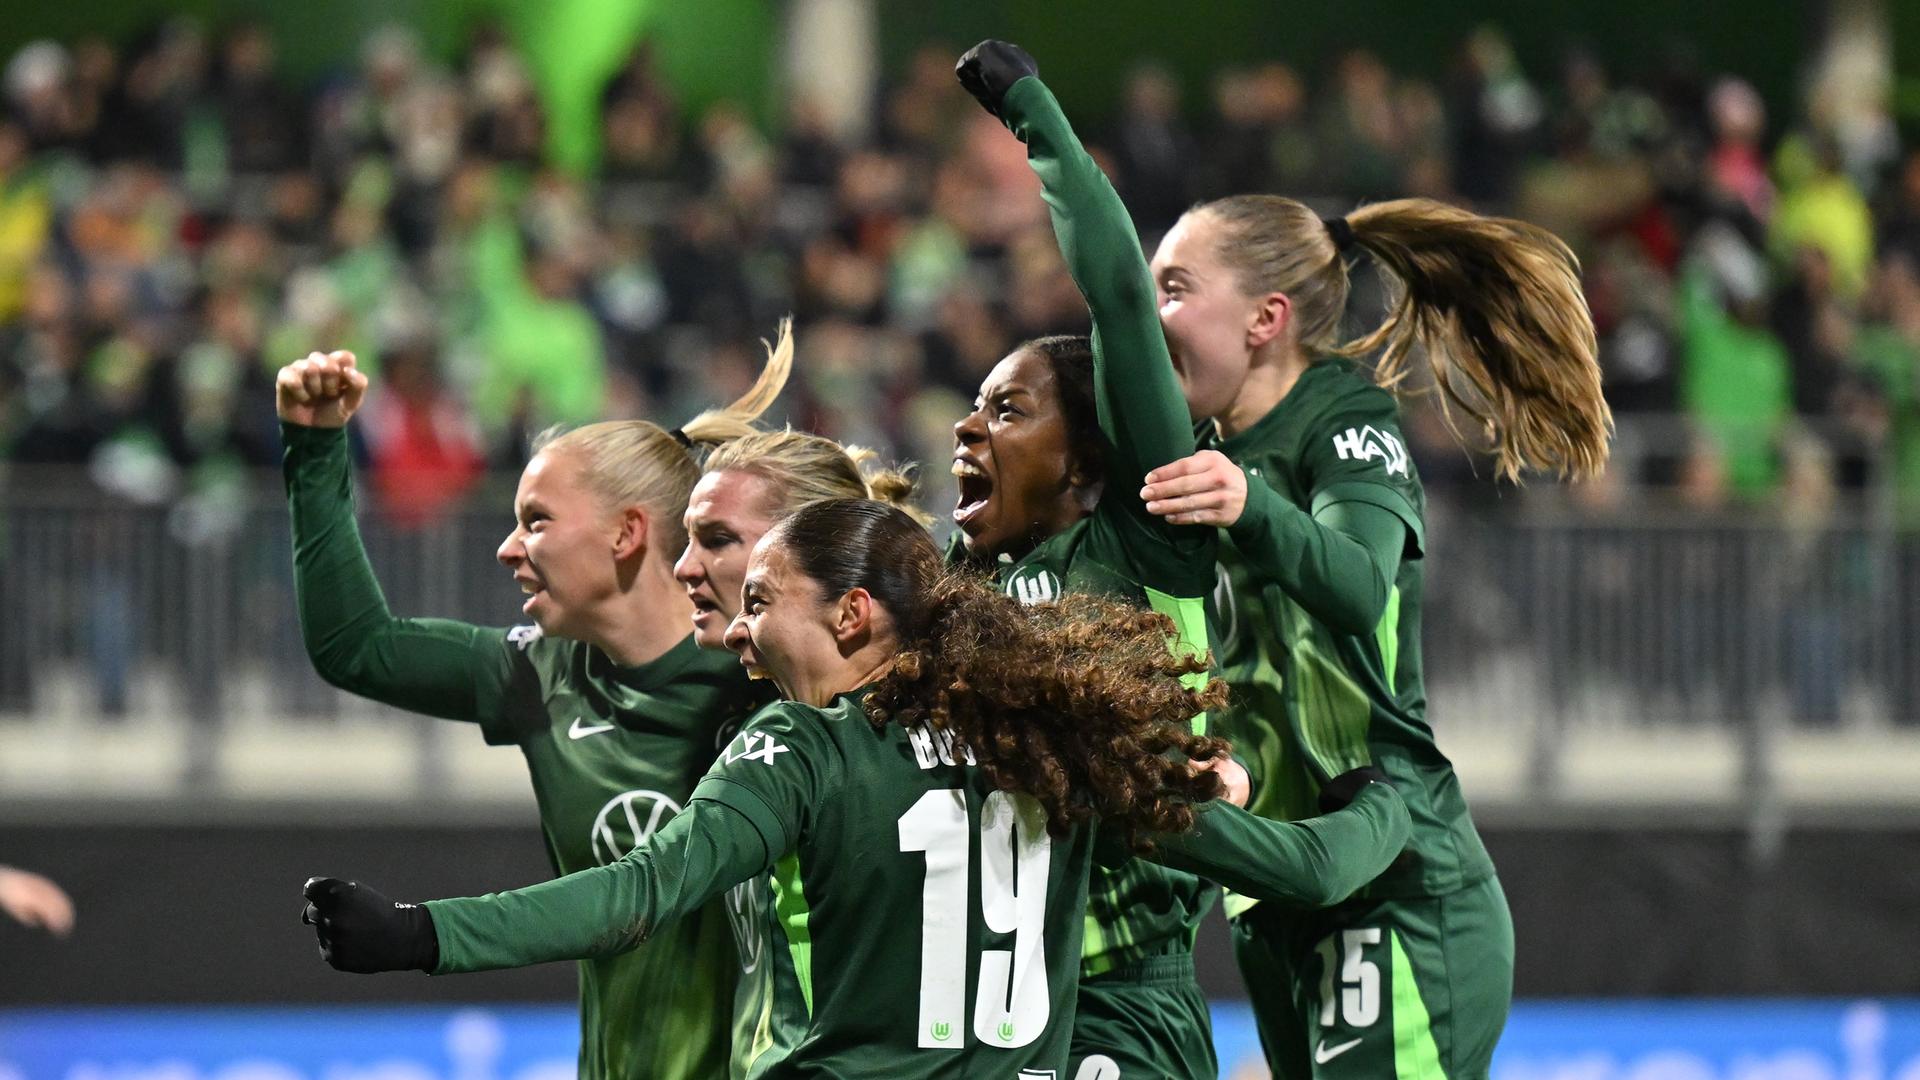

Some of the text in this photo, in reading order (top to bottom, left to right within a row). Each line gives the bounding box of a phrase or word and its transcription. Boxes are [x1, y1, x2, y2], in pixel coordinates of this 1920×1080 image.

[905, 719, 977, 770] BU
[898, 788, 1051, 1049] 19
[1314, 927, 1381, 1027] 15
